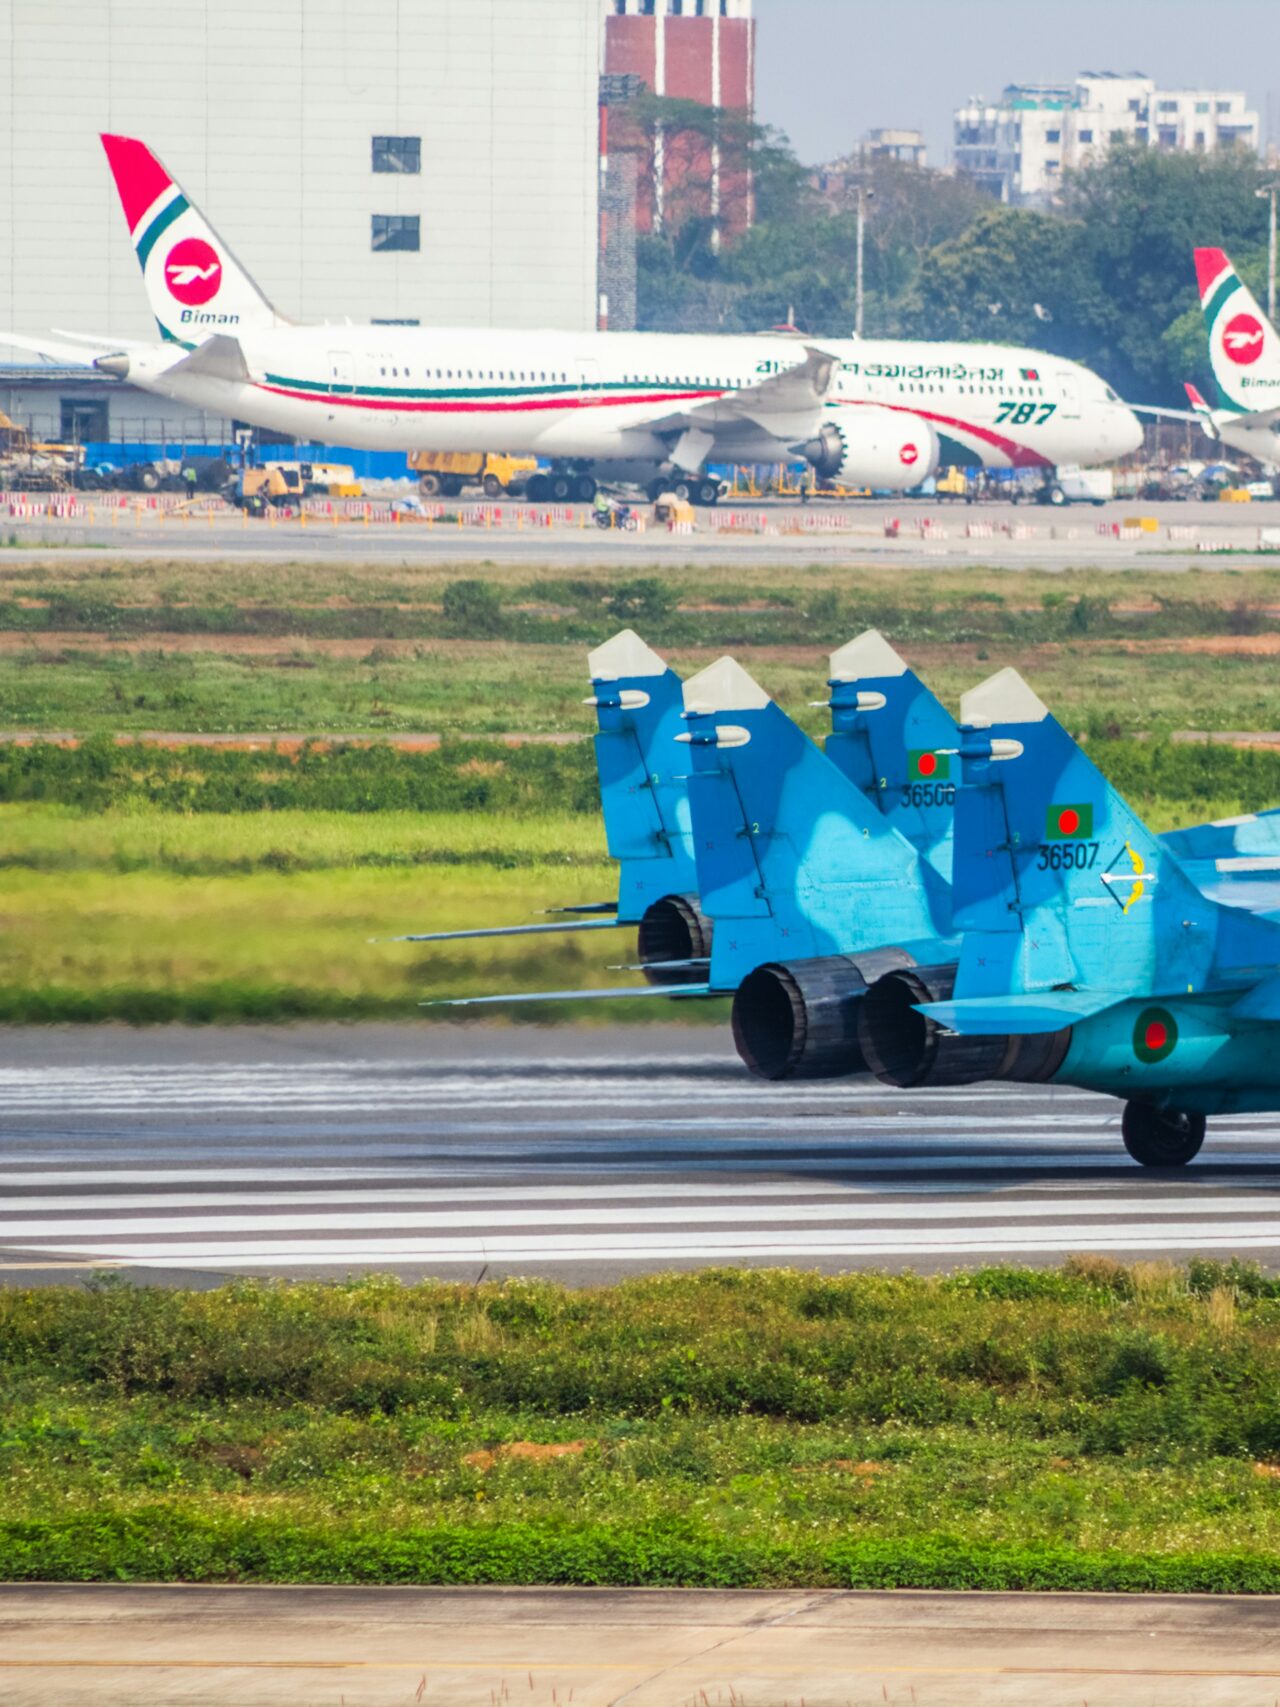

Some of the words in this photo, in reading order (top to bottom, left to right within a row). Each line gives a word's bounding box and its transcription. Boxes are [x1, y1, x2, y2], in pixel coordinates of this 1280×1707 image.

[181, 309, 240, 323] Biman
[993, 402, 1057, 424] 787
[1037, 842, 1099, 870] 36507
